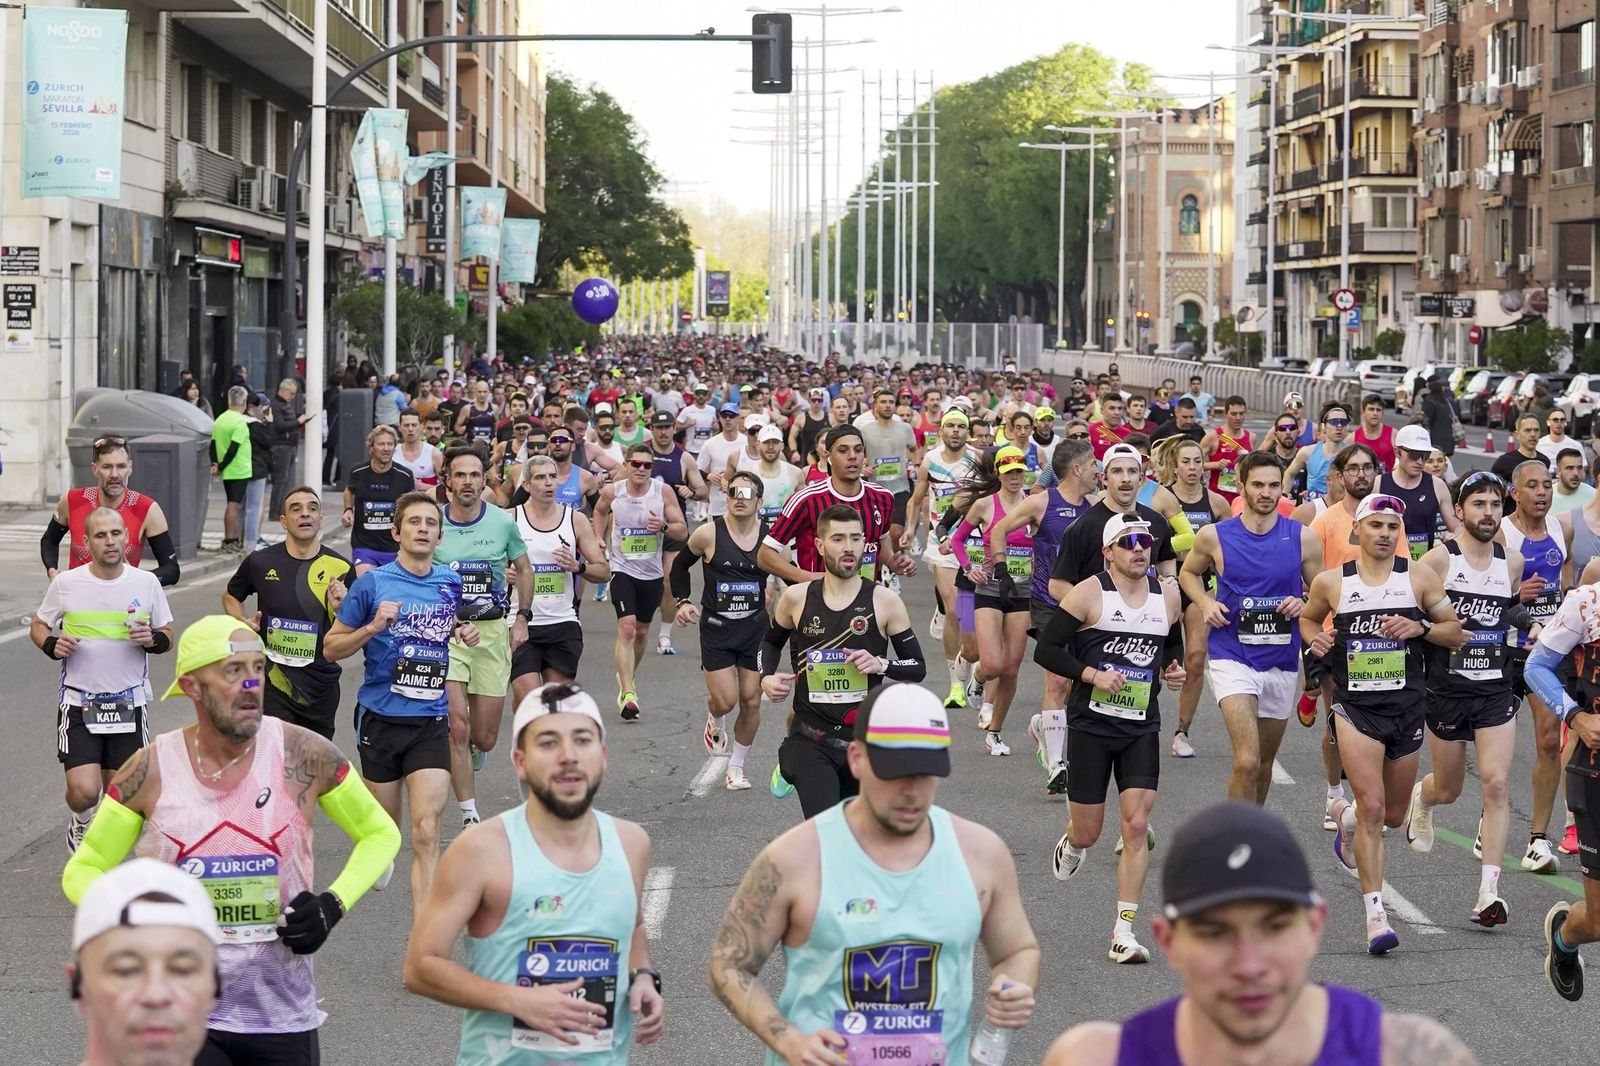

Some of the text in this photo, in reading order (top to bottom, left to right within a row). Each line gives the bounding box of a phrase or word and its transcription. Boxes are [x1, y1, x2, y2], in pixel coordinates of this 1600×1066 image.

[44, 83, 84, 92] ZURICH
[43, 94, 84, 104] MARATÓN
[42, 104, 84, 112] SEVILLA
[432, 166, 444, 236] ENTOFT
[11, 310, 28, 318] ZONA
[970, 556, 983, 564] IÑIG
[462, 584, 487, 592] STIEN
[400, 603, 456, 615] UNNERS
[284, 622, 312, 631] ZURICH
[1254, 623, 1277, 634] MAX
[268, 642, 314, 657] MARTINATOR
[418, 649, 444, 658] ZURICH
[826, 650, 847, 660] ZURI
[1463, 658, 1490, 669] HUGO
[416, 665, 431, 673] 4234
[1118, 669, 1146, 679] ZURICH
[1375, 669, 1404, 679] ALONSO
[397, 673, 443, 688] JAIME OP
[824, 680, 850, 690] DITO
[1106, 694, 1135, 706] JUAN
[97, 712, 121, 722] KATA
[212, 860, 266, 873] ZURICH
[214, 887, 242, 900] 3358
[556, 958, 610, 972] ZURICH
[873, 1016, 930, 1030] ZURICH
[872, 1046, 911, 1059] 10566
